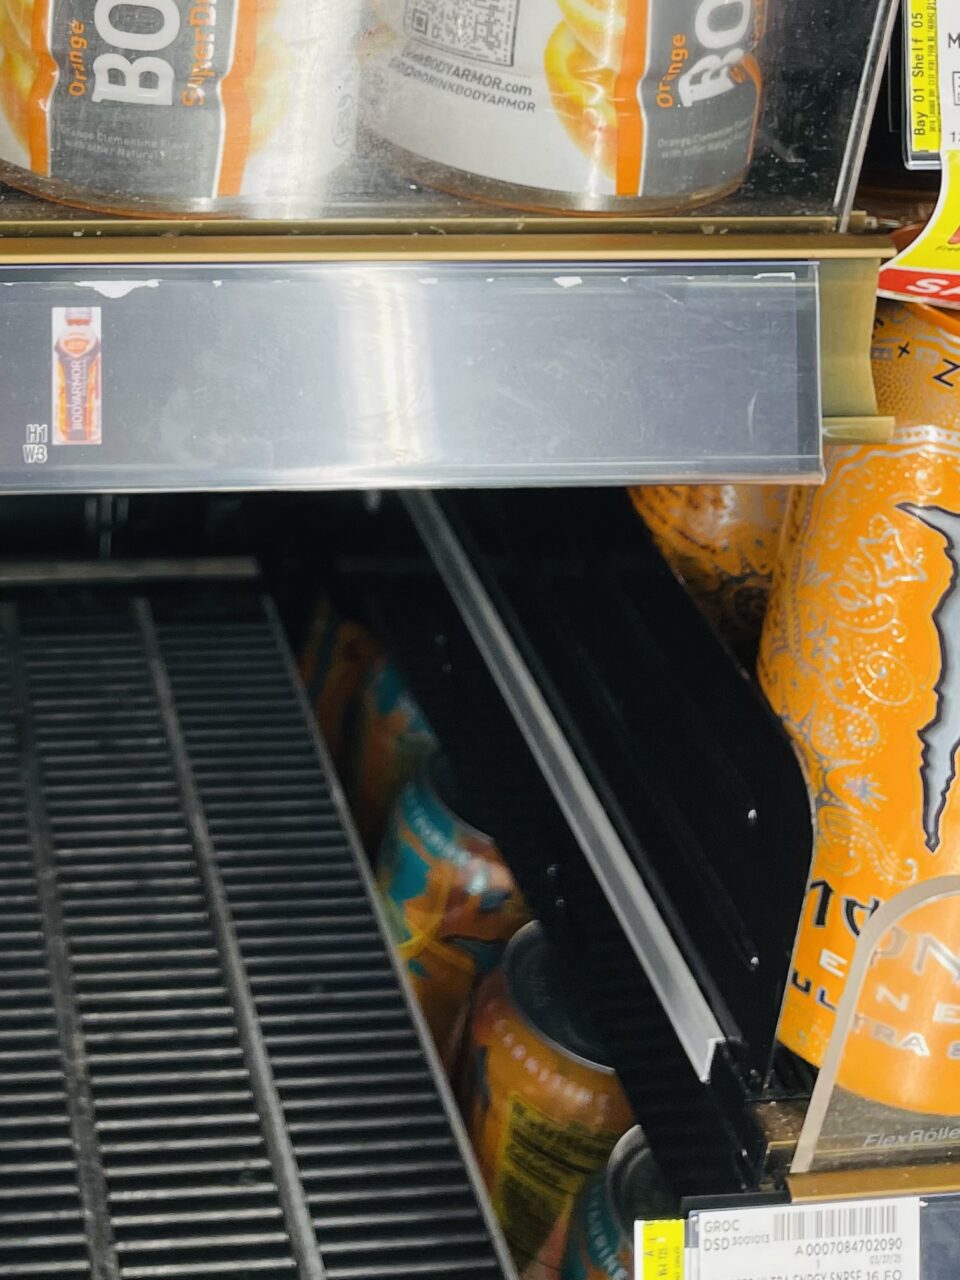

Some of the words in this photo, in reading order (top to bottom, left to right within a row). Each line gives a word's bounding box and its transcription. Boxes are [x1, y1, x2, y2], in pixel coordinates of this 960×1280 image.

[911, 11, 923, 28] 05
[69, 20, 88, 97] Orange
[911, 37, 925, 78] Shelf
[656, 33, 688, 108] Orange
[913, 91, 925, 103] 01
[912, 110, 929, 137] Bay
[26, 423, 48, 444] H1
[23, 443, 48, 464] W3
[704, 1219, 741, 1234] GROC
[704, 1238, 730, 1252] DSD
[806, 1237, 903, 1256] 0007084702090
